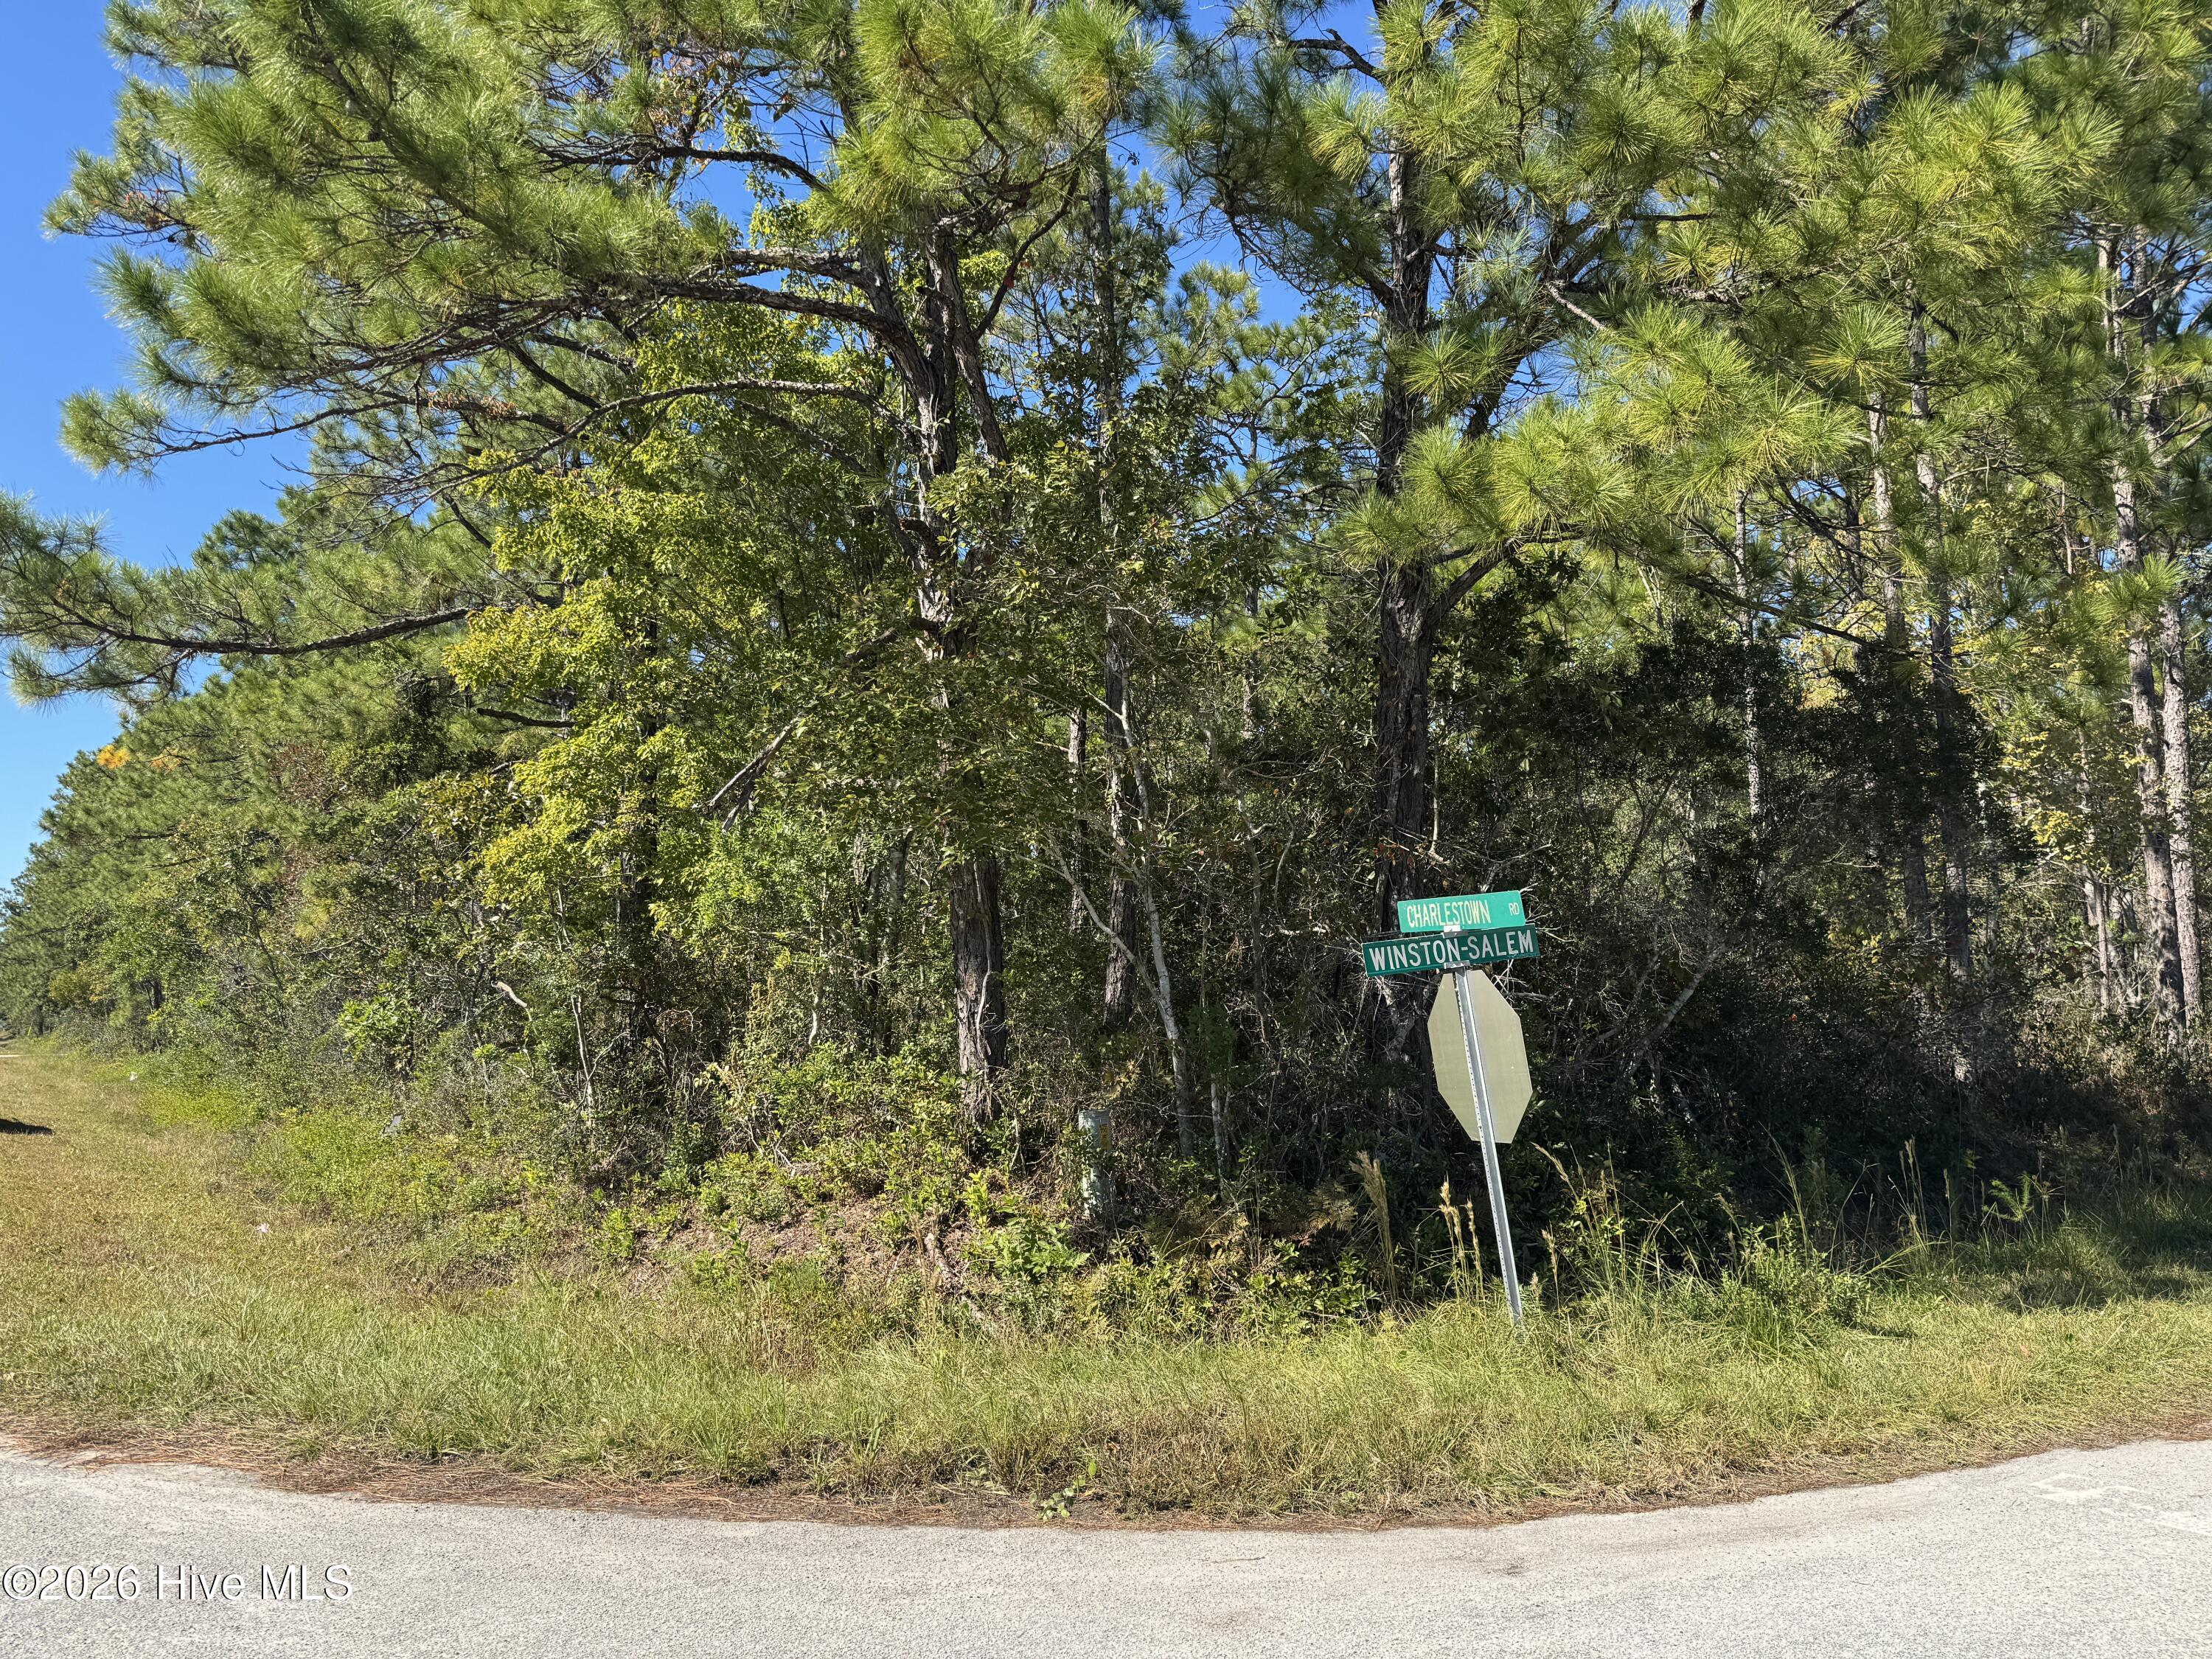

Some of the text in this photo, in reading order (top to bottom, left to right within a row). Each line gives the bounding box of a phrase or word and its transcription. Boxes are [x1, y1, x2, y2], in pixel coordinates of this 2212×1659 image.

[1407, 900, 1520, 928] CHARLESTOWN RD
[1369, 929, 1534, 971] WINSTON-SALEM
